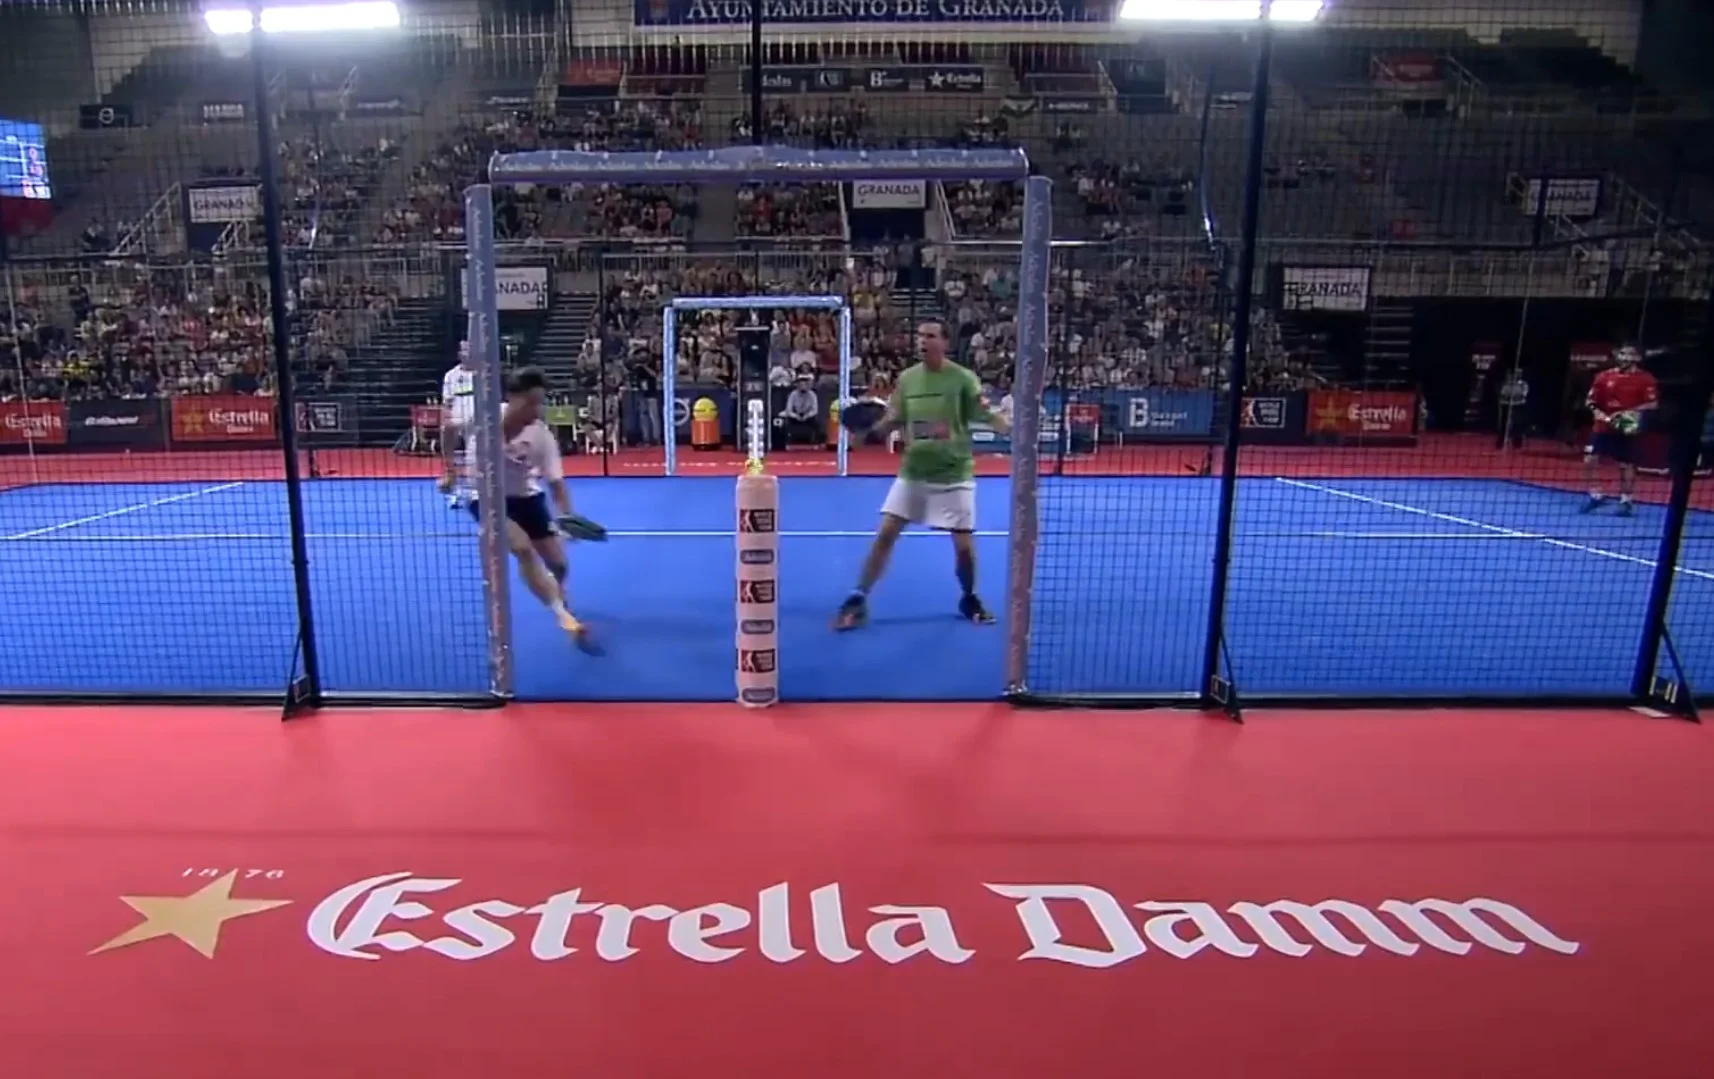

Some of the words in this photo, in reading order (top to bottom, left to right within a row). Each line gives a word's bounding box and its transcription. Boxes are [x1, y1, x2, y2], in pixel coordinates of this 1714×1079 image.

[897, 0, 929, 16] DE
[939, 0, 1064, 17] GRANADA
[858, 184, 920, 195] GRANADA
[495, 281, 540, 294] NADA
[5, 413, 62, 429] Estrella
[209, 408, 269, 425] Estrella
[1348, 403, 1407, 422] Estrella
[306, 870, 976, 964] Estrella
[981, 881, 1580, 968] Damm
